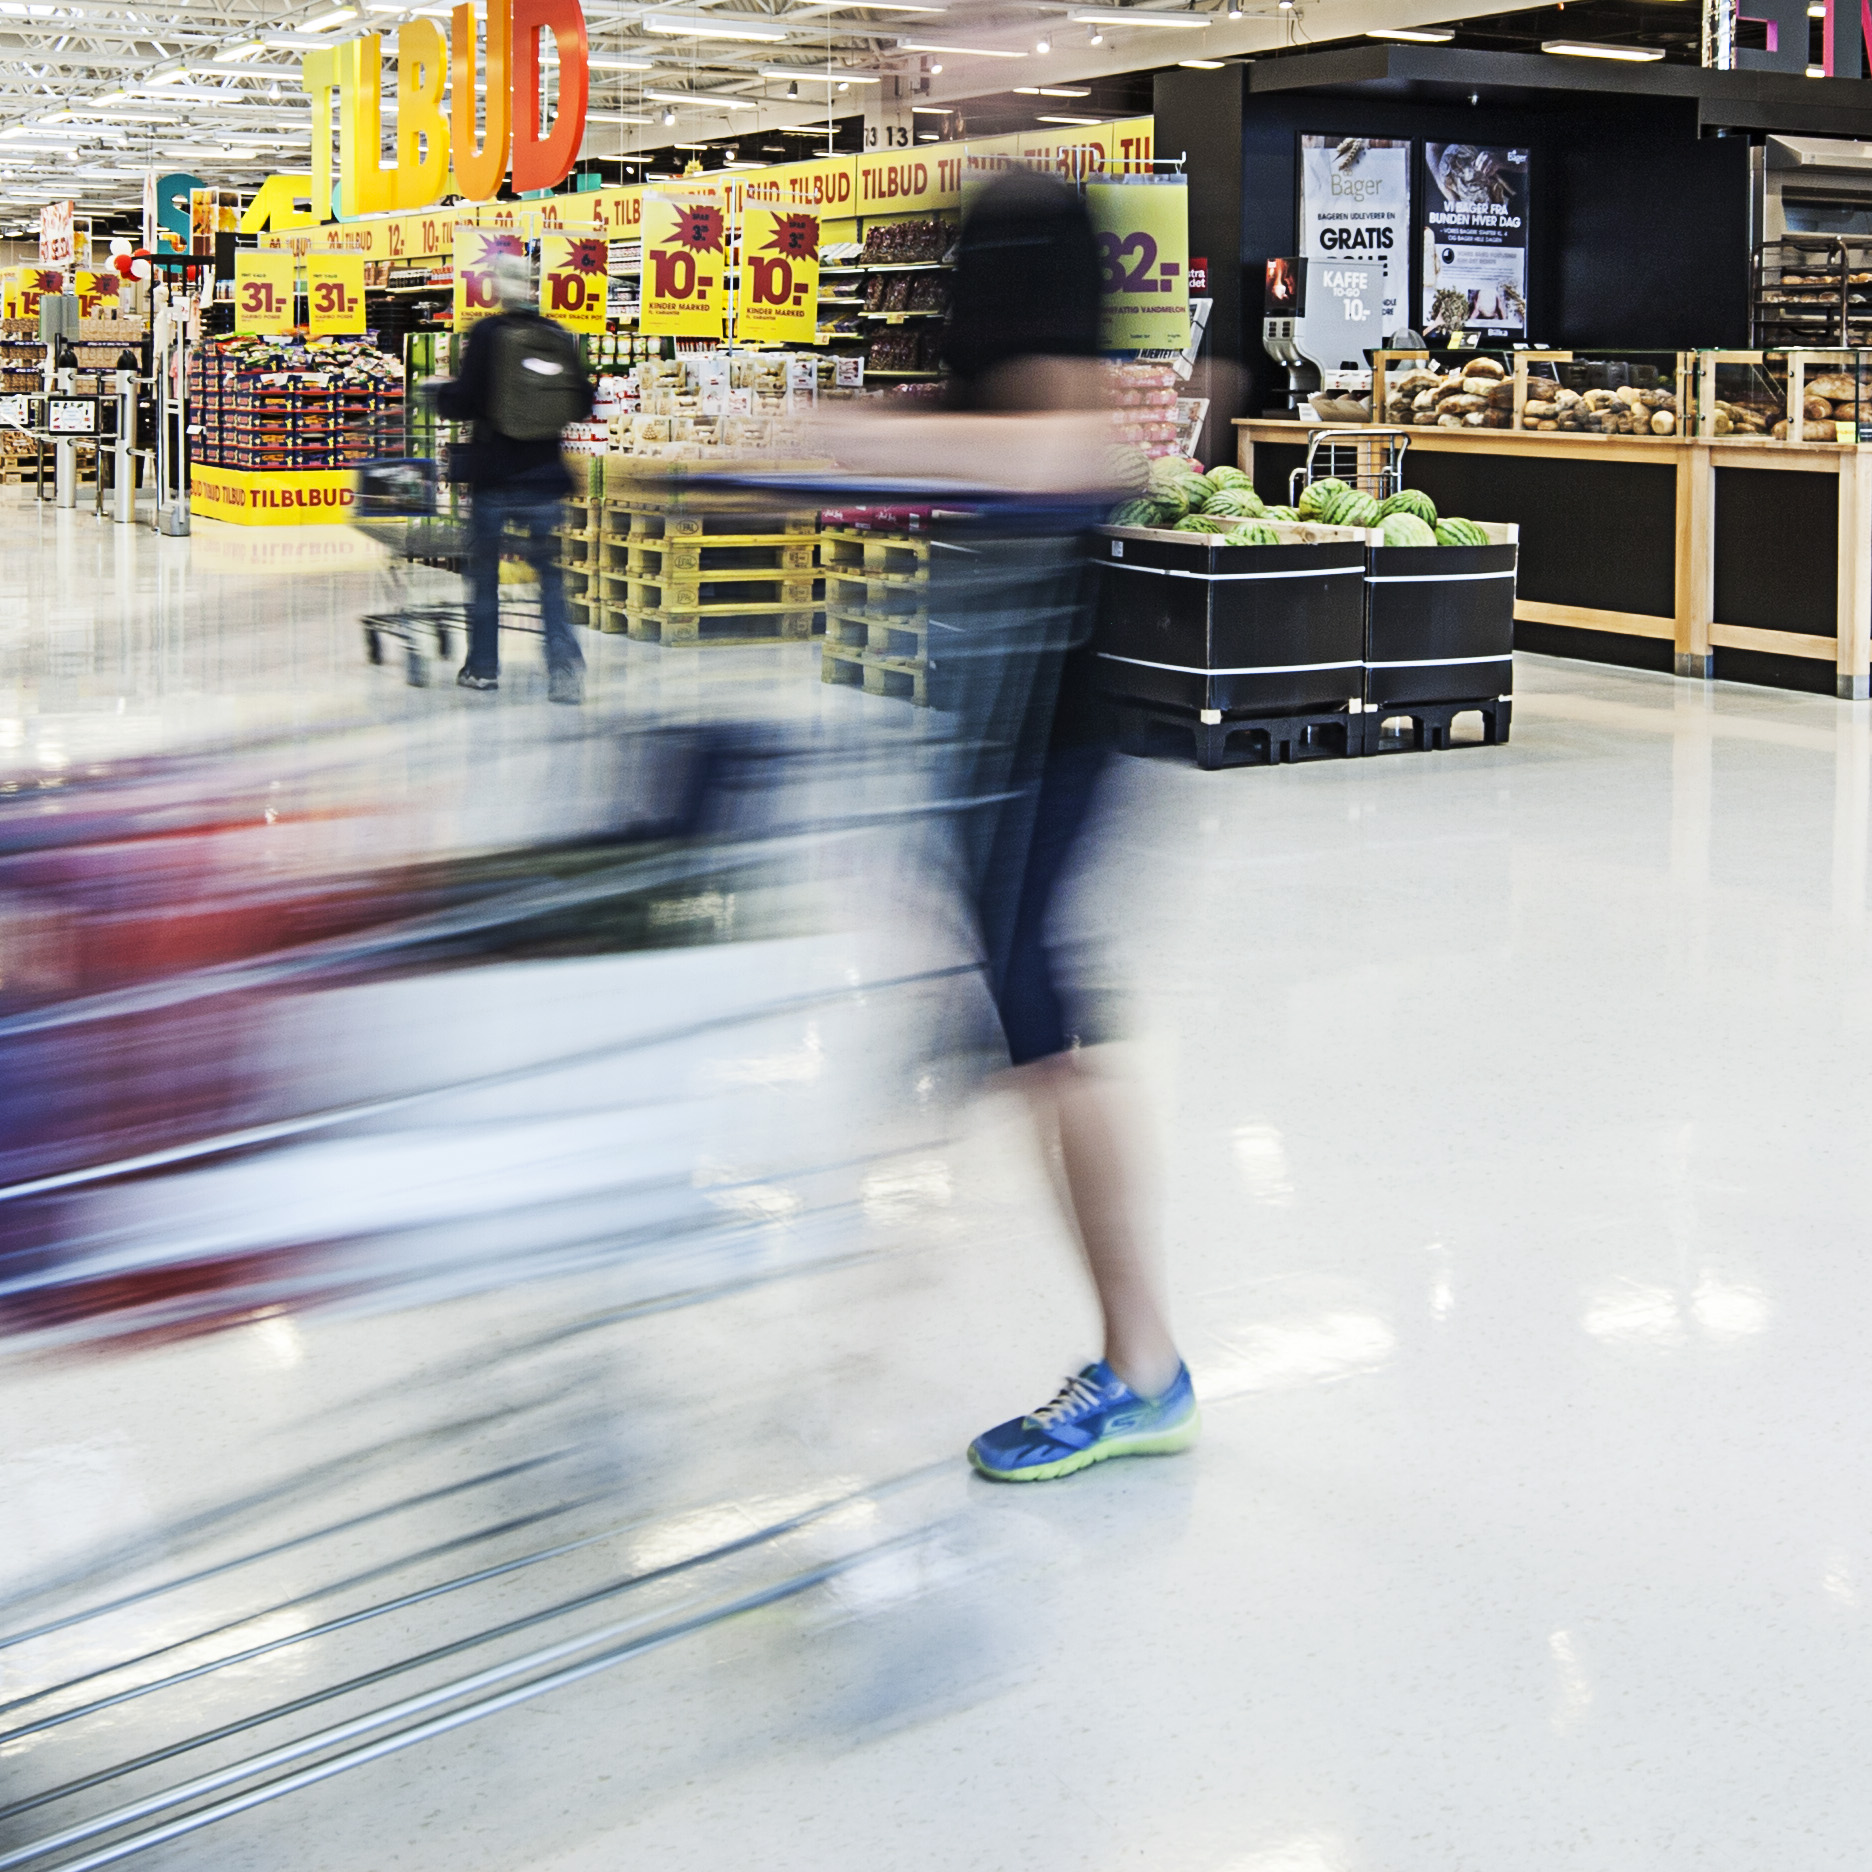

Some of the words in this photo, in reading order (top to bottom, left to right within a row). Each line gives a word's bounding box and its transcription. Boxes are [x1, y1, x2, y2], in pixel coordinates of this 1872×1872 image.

[886, 127, 909, 147] 13
[790, 172, 851, 208] TILBUD
[862, 163, 929, 200] TILBUD
[1331, 173, 1383, 202] Bager
[1444, 201, 1454, 212] VI
[1456, 202, 1489, 214] BAGER
[1490, 203, 1509, 216] FRA
[1429, 212, 1470, 226] BUNDEN
[1471, 213, 1498, 227] HVER
[1499, 215, 1522, 229] DAG
[1319, 227, 1394, 250] GRATIS
[1323, 270, 1368, 290] KAFFE
[1333, 287, 1360, 297] TO-GO
